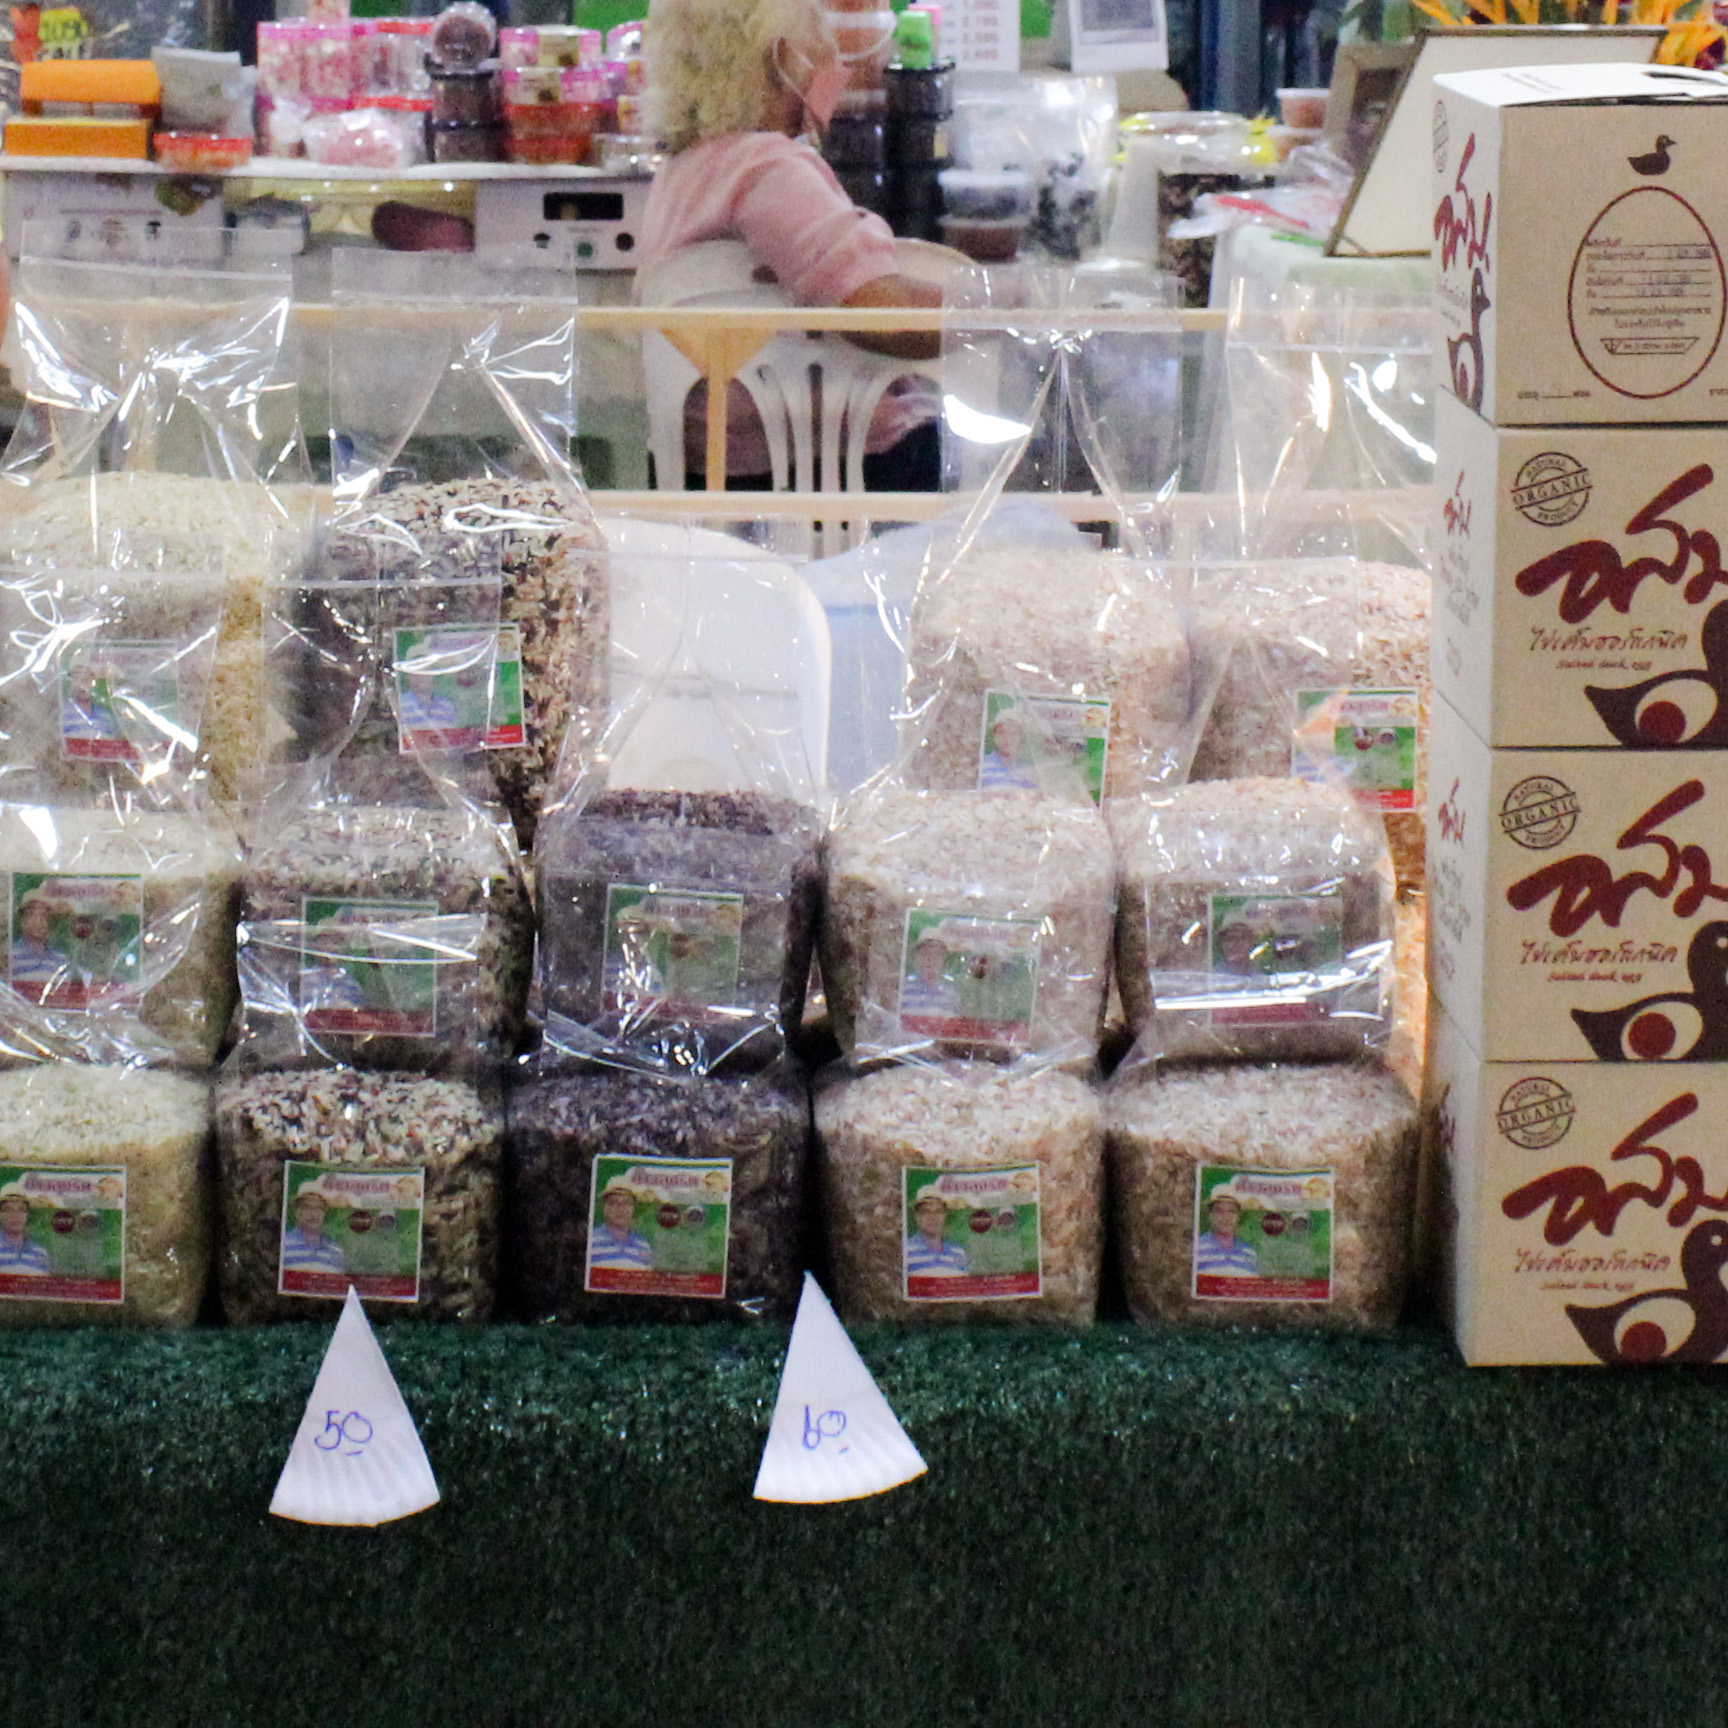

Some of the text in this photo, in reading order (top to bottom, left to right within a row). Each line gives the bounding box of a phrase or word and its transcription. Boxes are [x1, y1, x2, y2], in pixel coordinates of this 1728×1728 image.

[1513, 472, 1591, 505] ORGANIC
[1501, 795, 1579, 828] ORGANIC
[1498, 1096, 1576, 1129] ORGANIC
[314, 1410, 373, 1450] 50
[802, 1405, 847, 1450] 60
